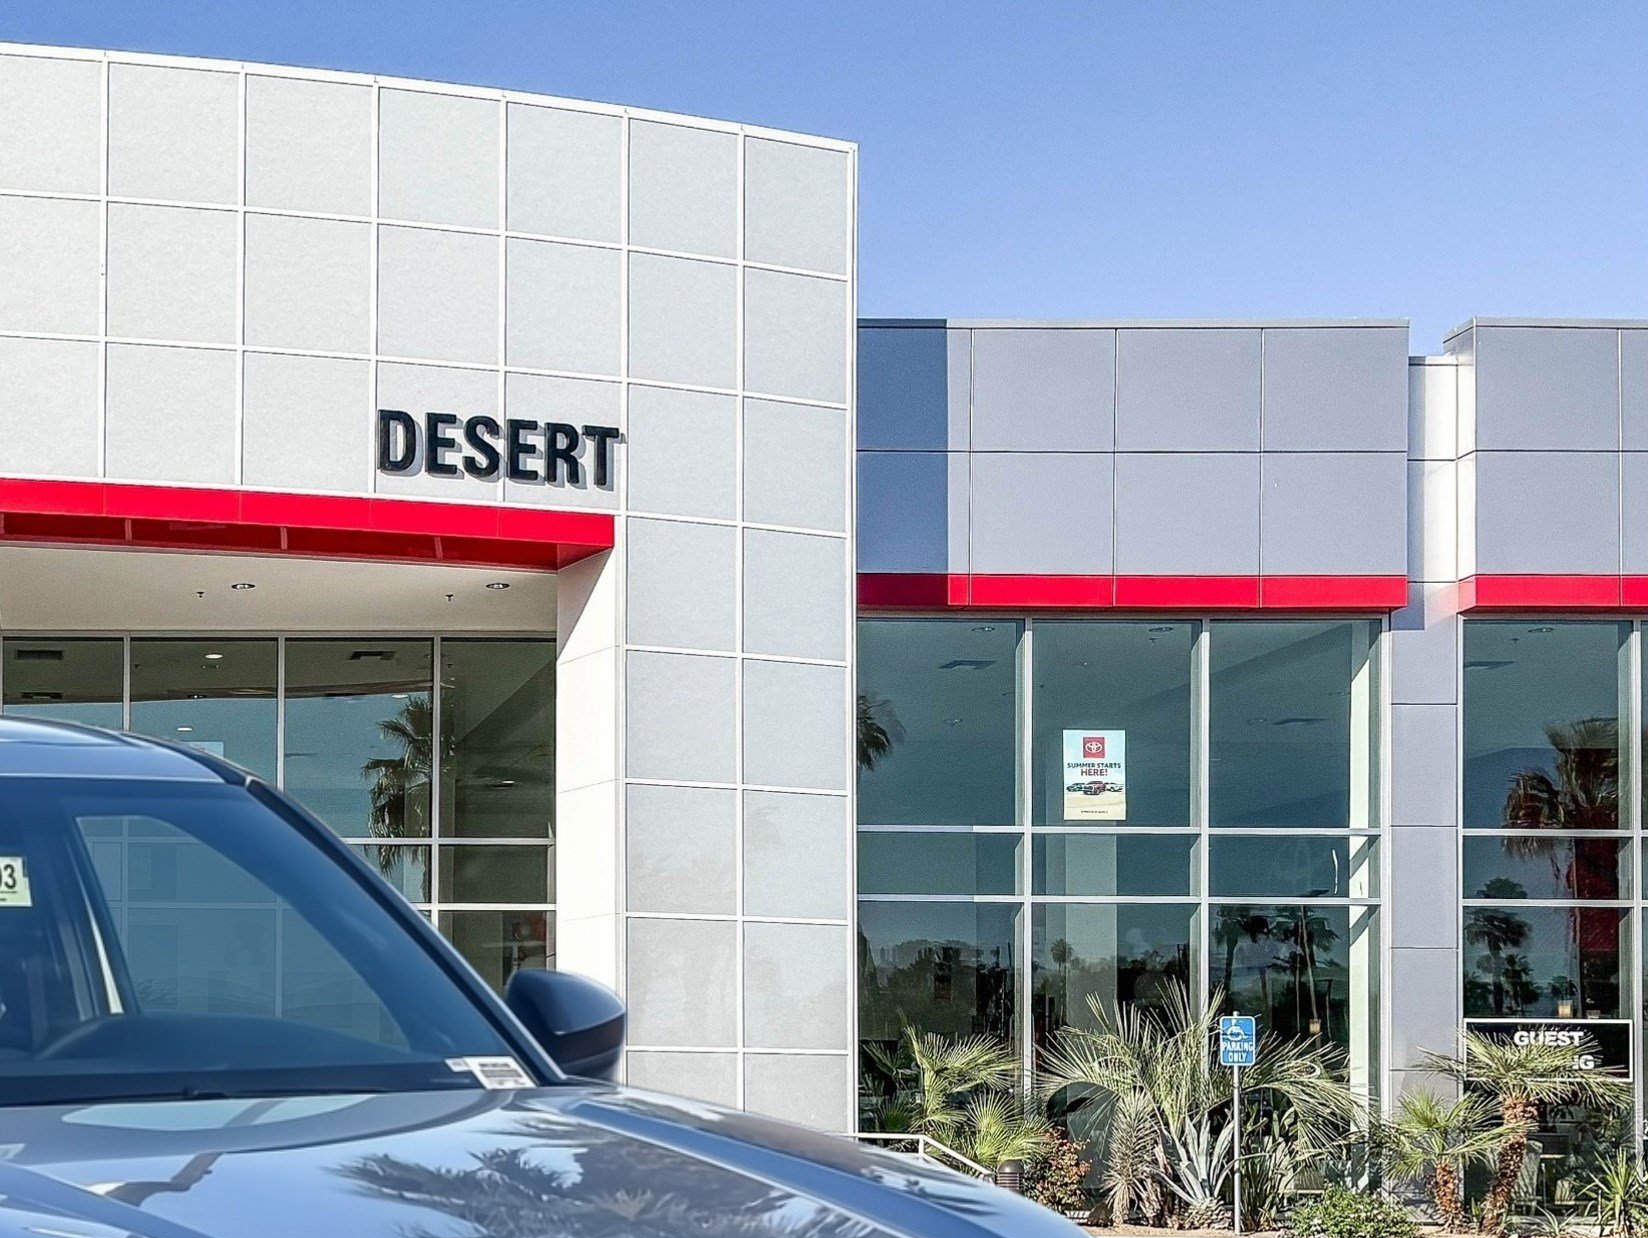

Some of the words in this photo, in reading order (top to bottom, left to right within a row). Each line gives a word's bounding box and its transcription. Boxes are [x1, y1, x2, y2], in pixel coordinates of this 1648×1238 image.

[376, 409, 621, 487] DESERT
[1081, 768, 1108, 777] HERE!
[1513, 1030, 1585, 1047] GUEST
[1222, 1041, 1254, 1052] PARKING
[1228, 1052, 1247, 1062] ONLY
